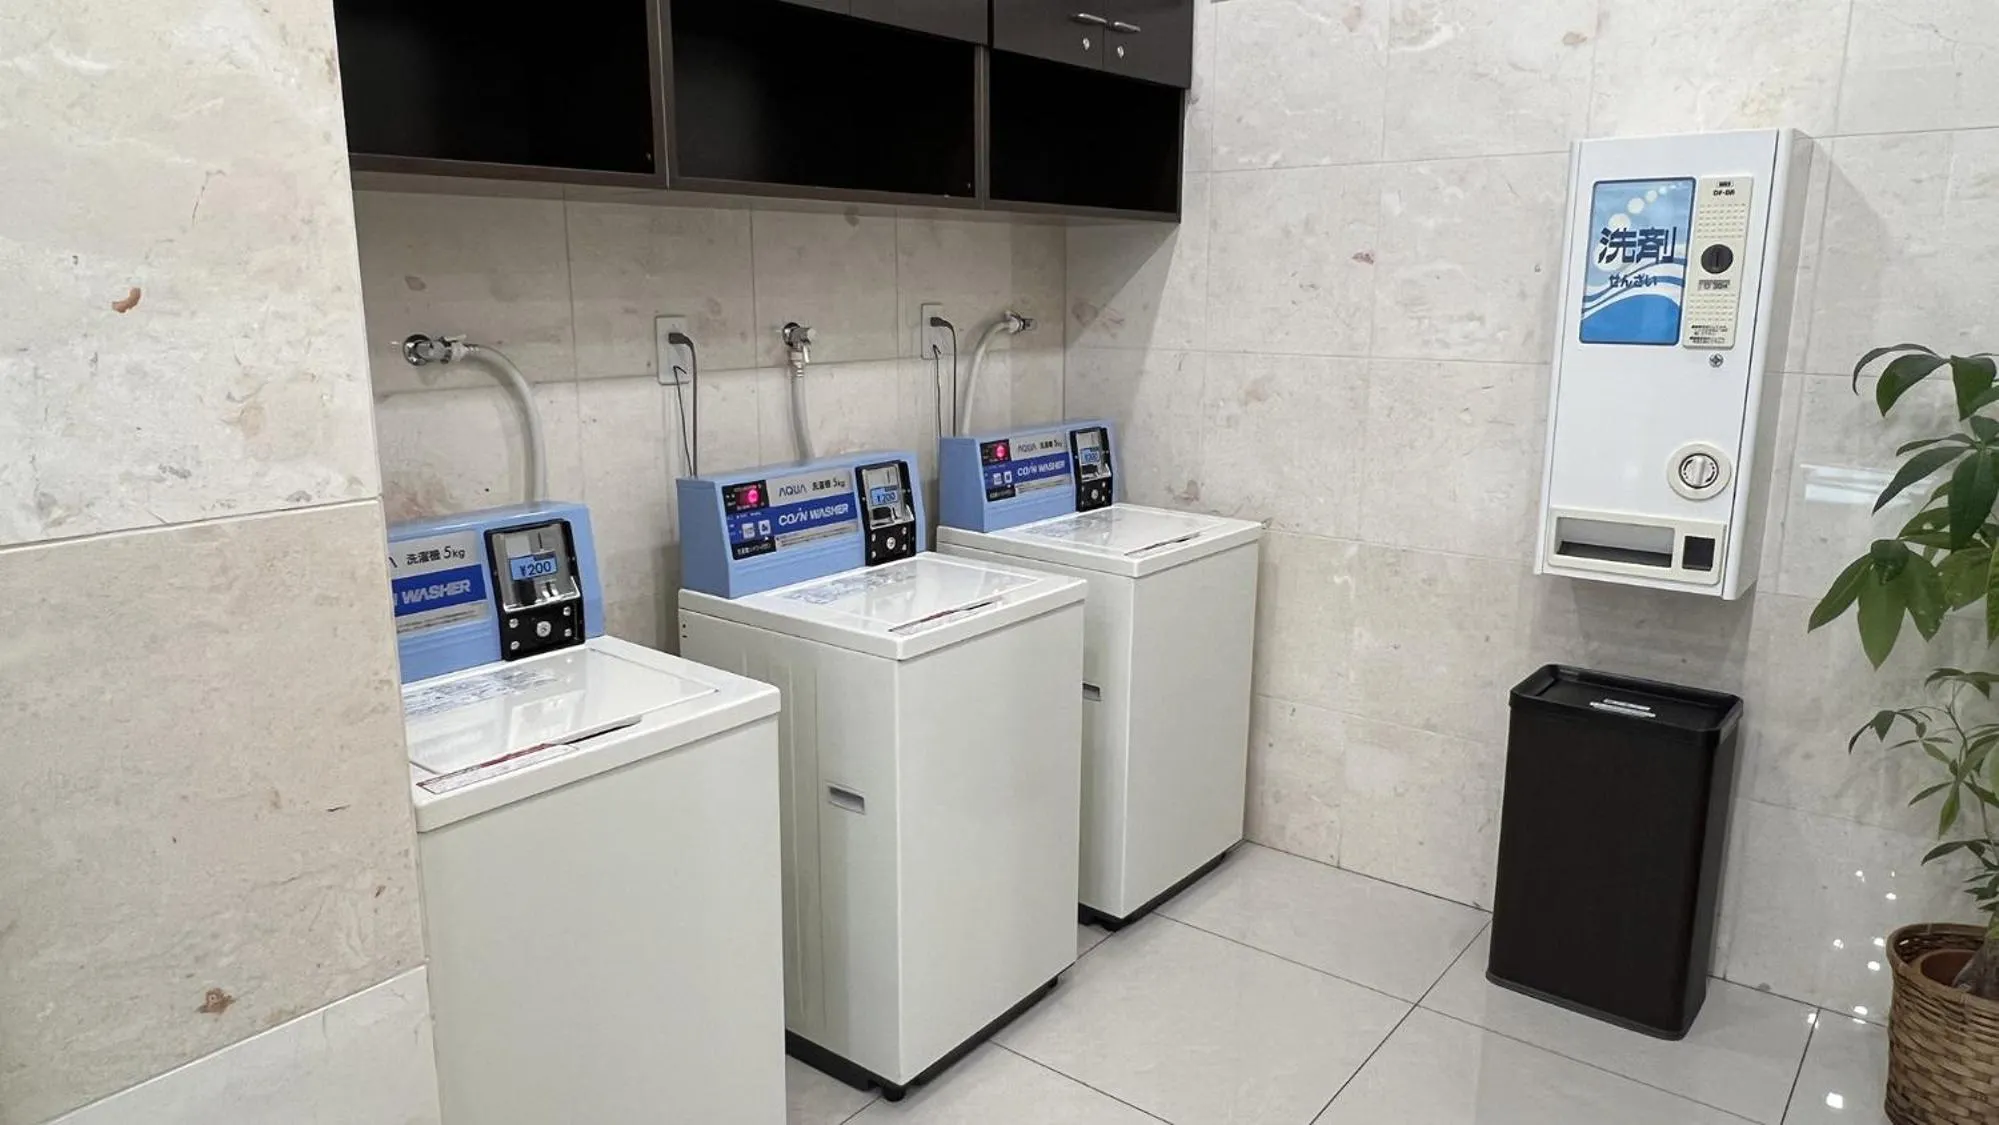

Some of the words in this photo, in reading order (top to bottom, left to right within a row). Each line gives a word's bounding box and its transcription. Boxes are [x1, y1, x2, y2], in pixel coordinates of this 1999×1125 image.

[1598, 226, 1677, 264] 洗剤
[1609, 274, 1657, 287] せんざい
[1038, 460, 1065, 472] WASHER
[778, 485, 807, 497] AQUA
[809, 503, 849, 520] WASHER
[406, 549, 441, 566] 洗濯機
[443, 546, 466, 559] 5kg
[519, 560, 552, 577] ¥200
[402, 580, 471, 604] WASHER
